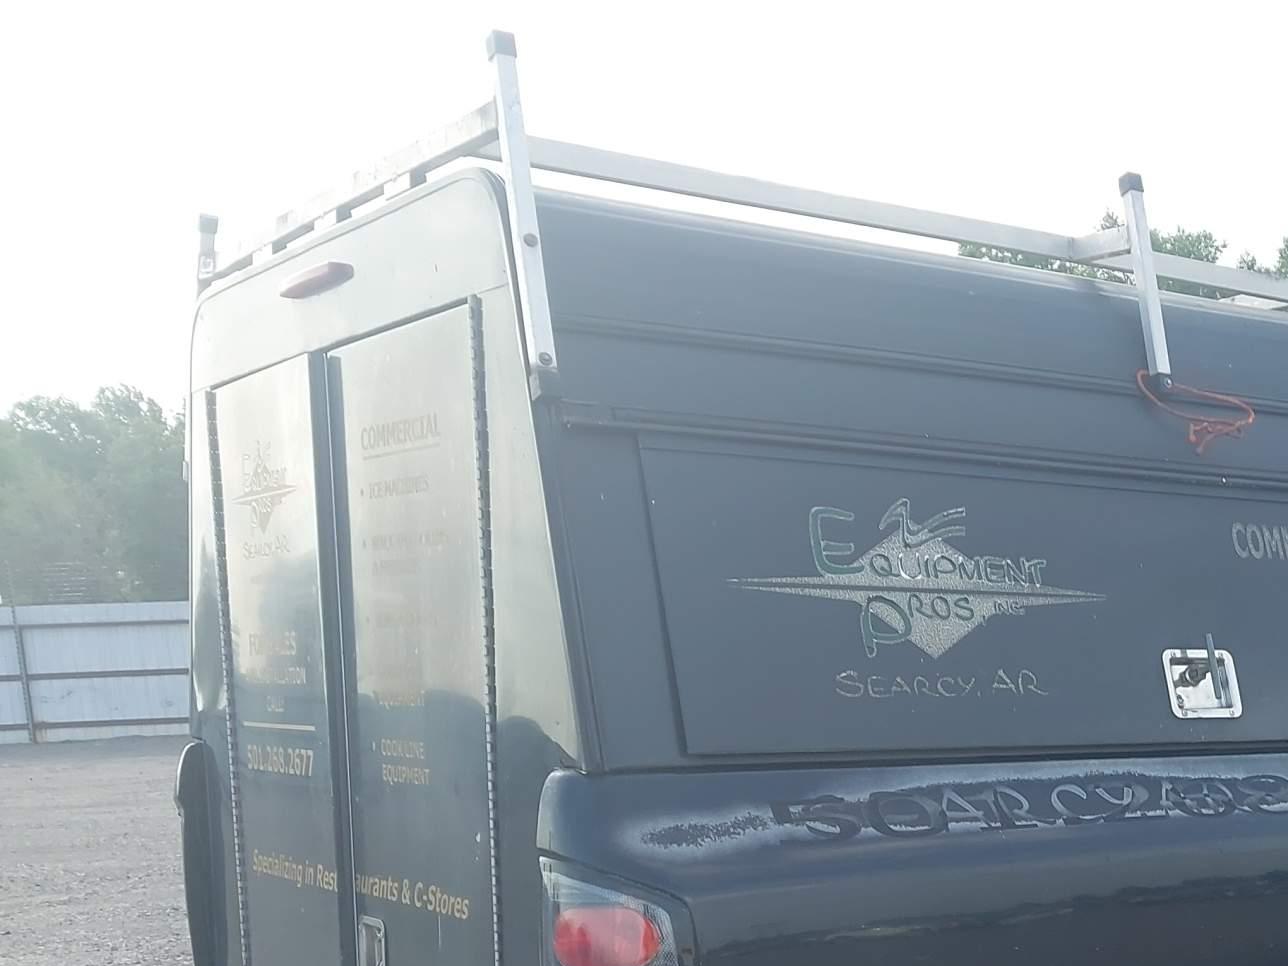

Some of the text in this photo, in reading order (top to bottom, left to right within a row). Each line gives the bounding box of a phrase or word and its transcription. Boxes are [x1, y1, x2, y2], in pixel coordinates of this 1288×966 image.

[360, 412, 440, 451] COMMERCIAL
[808, 506, 1047, 588] EQUIPMENT
[992, 667, 1049, 696] AR
[247, 744, 314, 777] 501.268.2677
[382, 763, 430, 786] EQUIPMENT
[252, 849, 302, 888] Specializing
[304, 860, 314, 886] in
[401, 878, 411, 905] &
[414, 881, 469, 920] C-Stores
